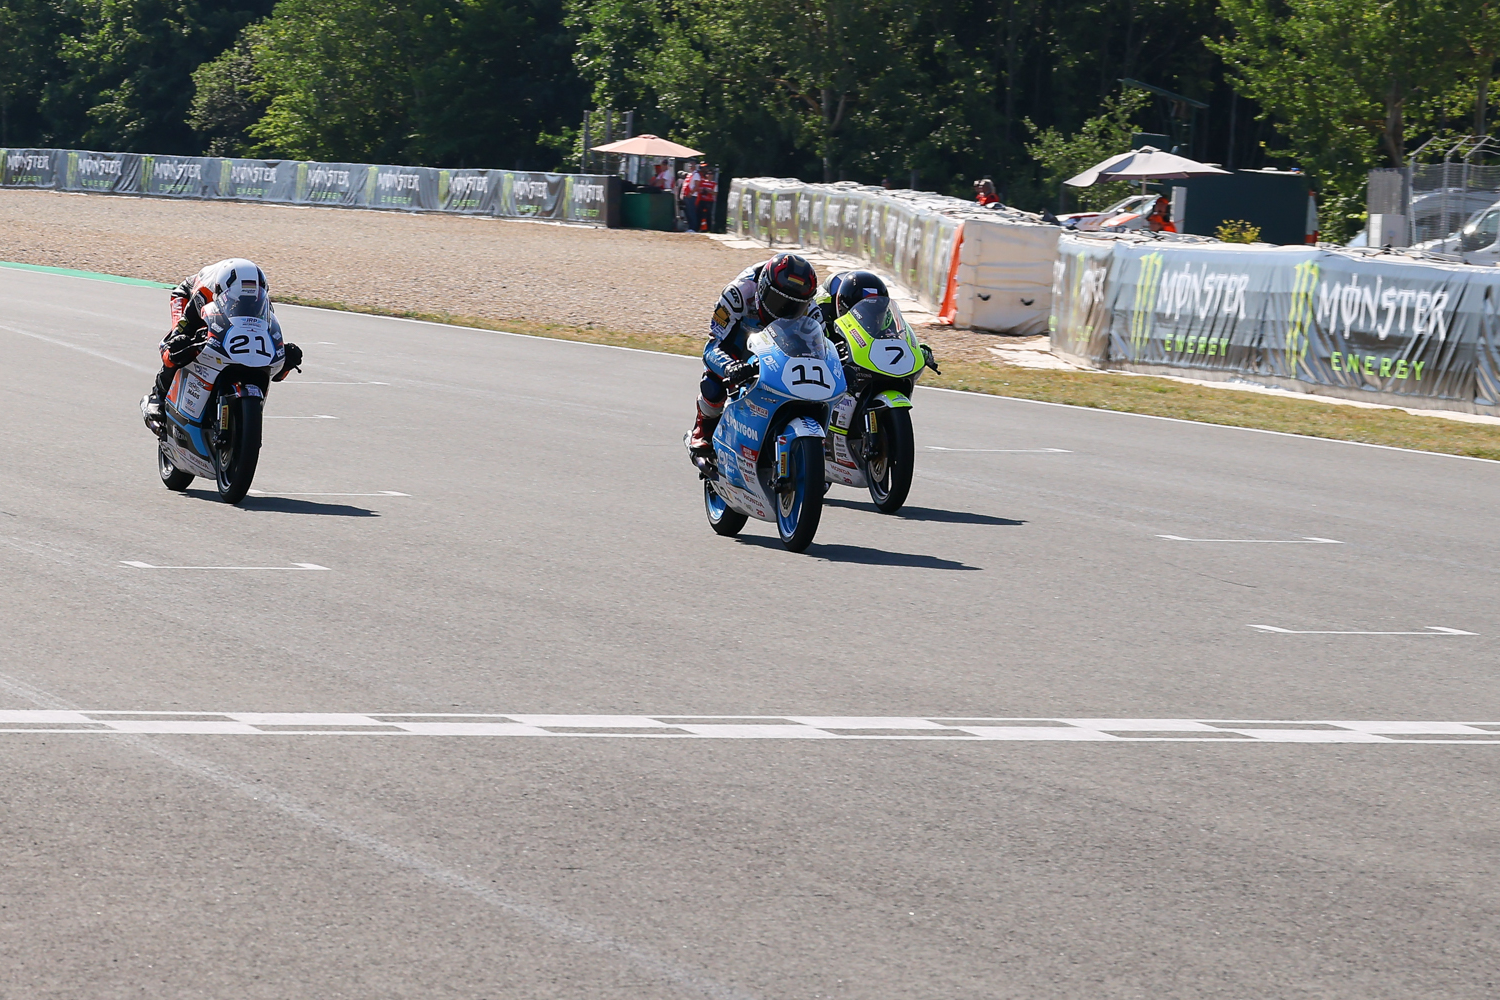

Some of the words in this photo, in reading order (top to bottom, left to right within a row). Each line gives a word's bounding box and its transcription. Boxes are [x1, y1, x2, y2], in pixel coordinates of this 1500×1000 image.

[1157, 262, 1249, 320] MONSTER
[1317, 273, 1449, 341] MONSTER
[230, 335, 271, 358] 21
[885, 346, 904, 365] 7
[1165, 334, 1230, 356] ENERGY
[792, 364, 831, 389] 11
[1331, 352, 1425, 380] ENERGY
[730, 416, 758, 441] POLYGON
[743, 493, 765, 508] HONDA
